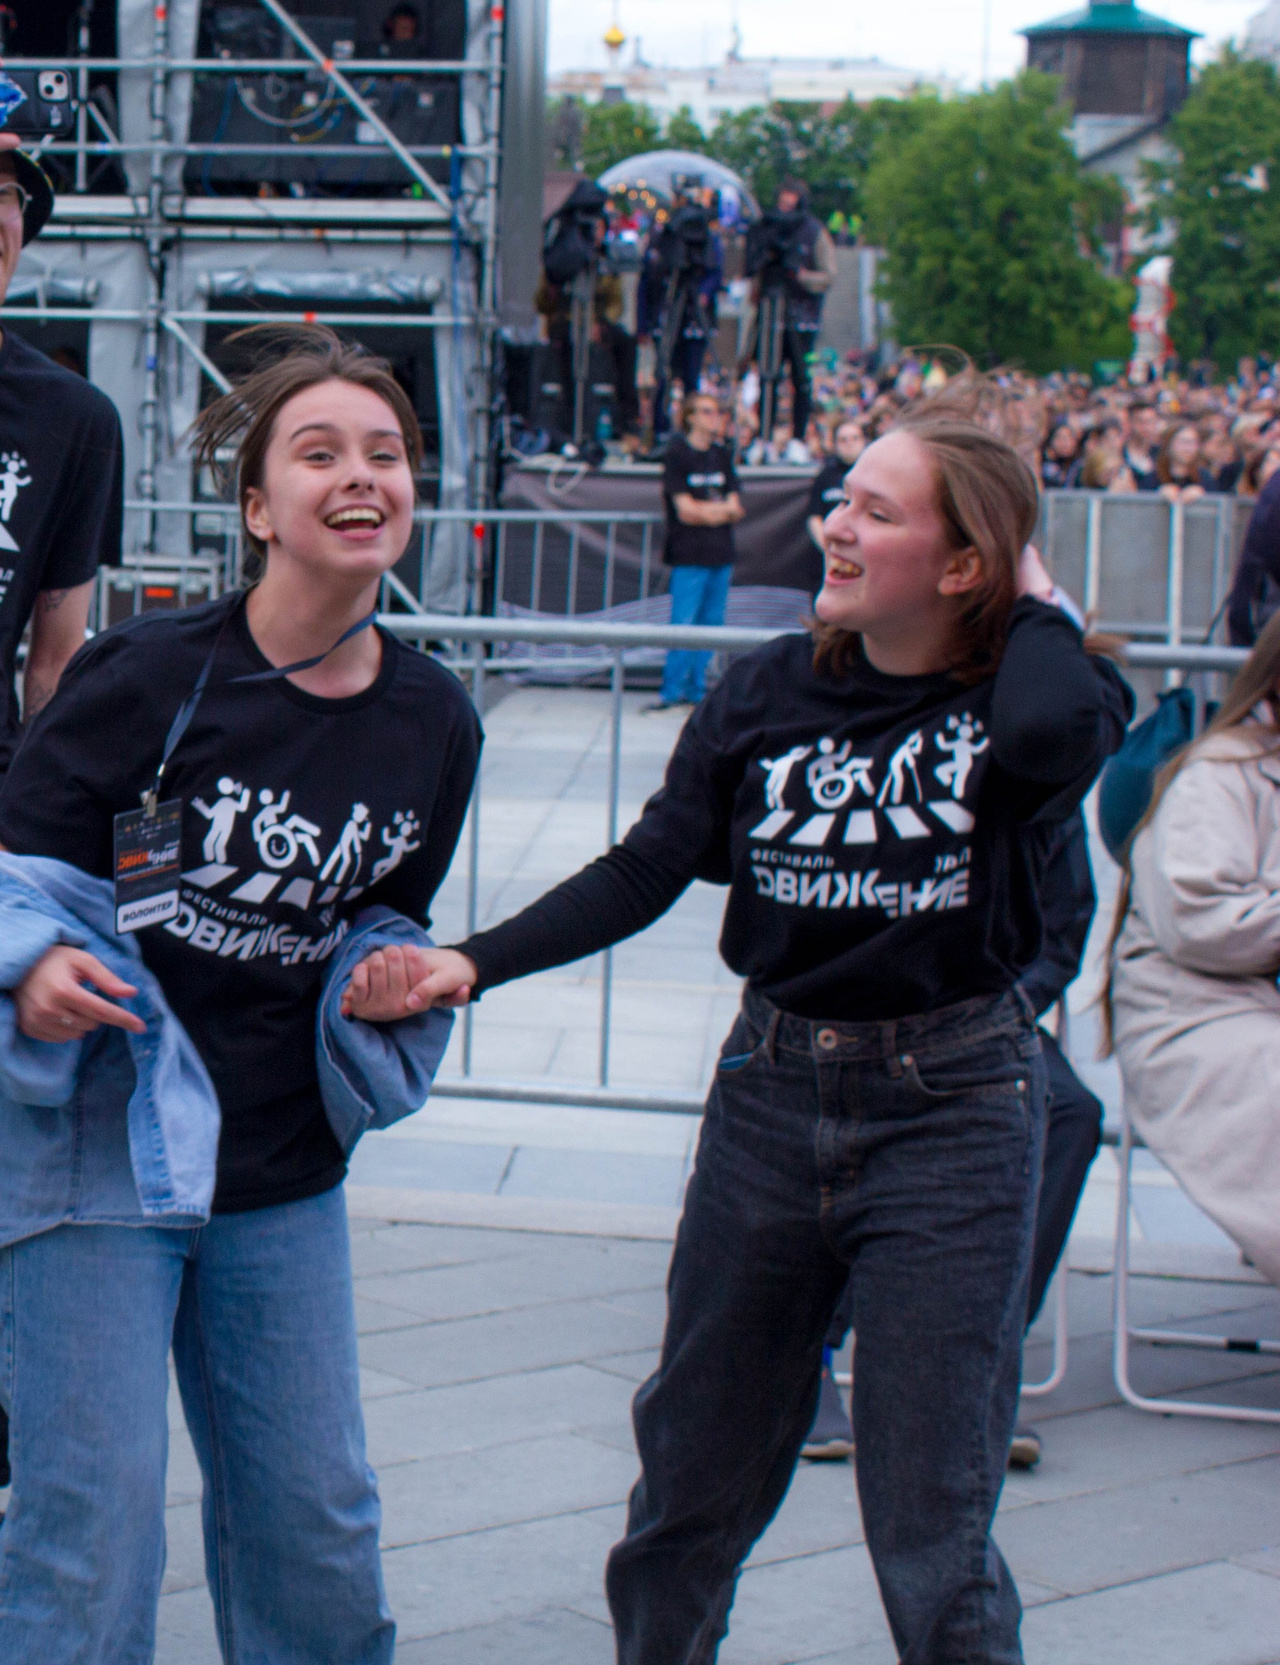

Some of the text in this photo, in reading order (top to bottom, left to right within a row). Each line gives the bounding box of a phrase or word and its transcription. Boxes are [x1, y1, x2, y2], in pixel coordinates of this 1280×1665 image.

[750, 848, 835, 869] ФЕСТИВАЛЬ
[122, 900, 174, 923] ВОЛОНТЕР
[181, 887, 268, 926] ФЕСТИВАЛЬ
